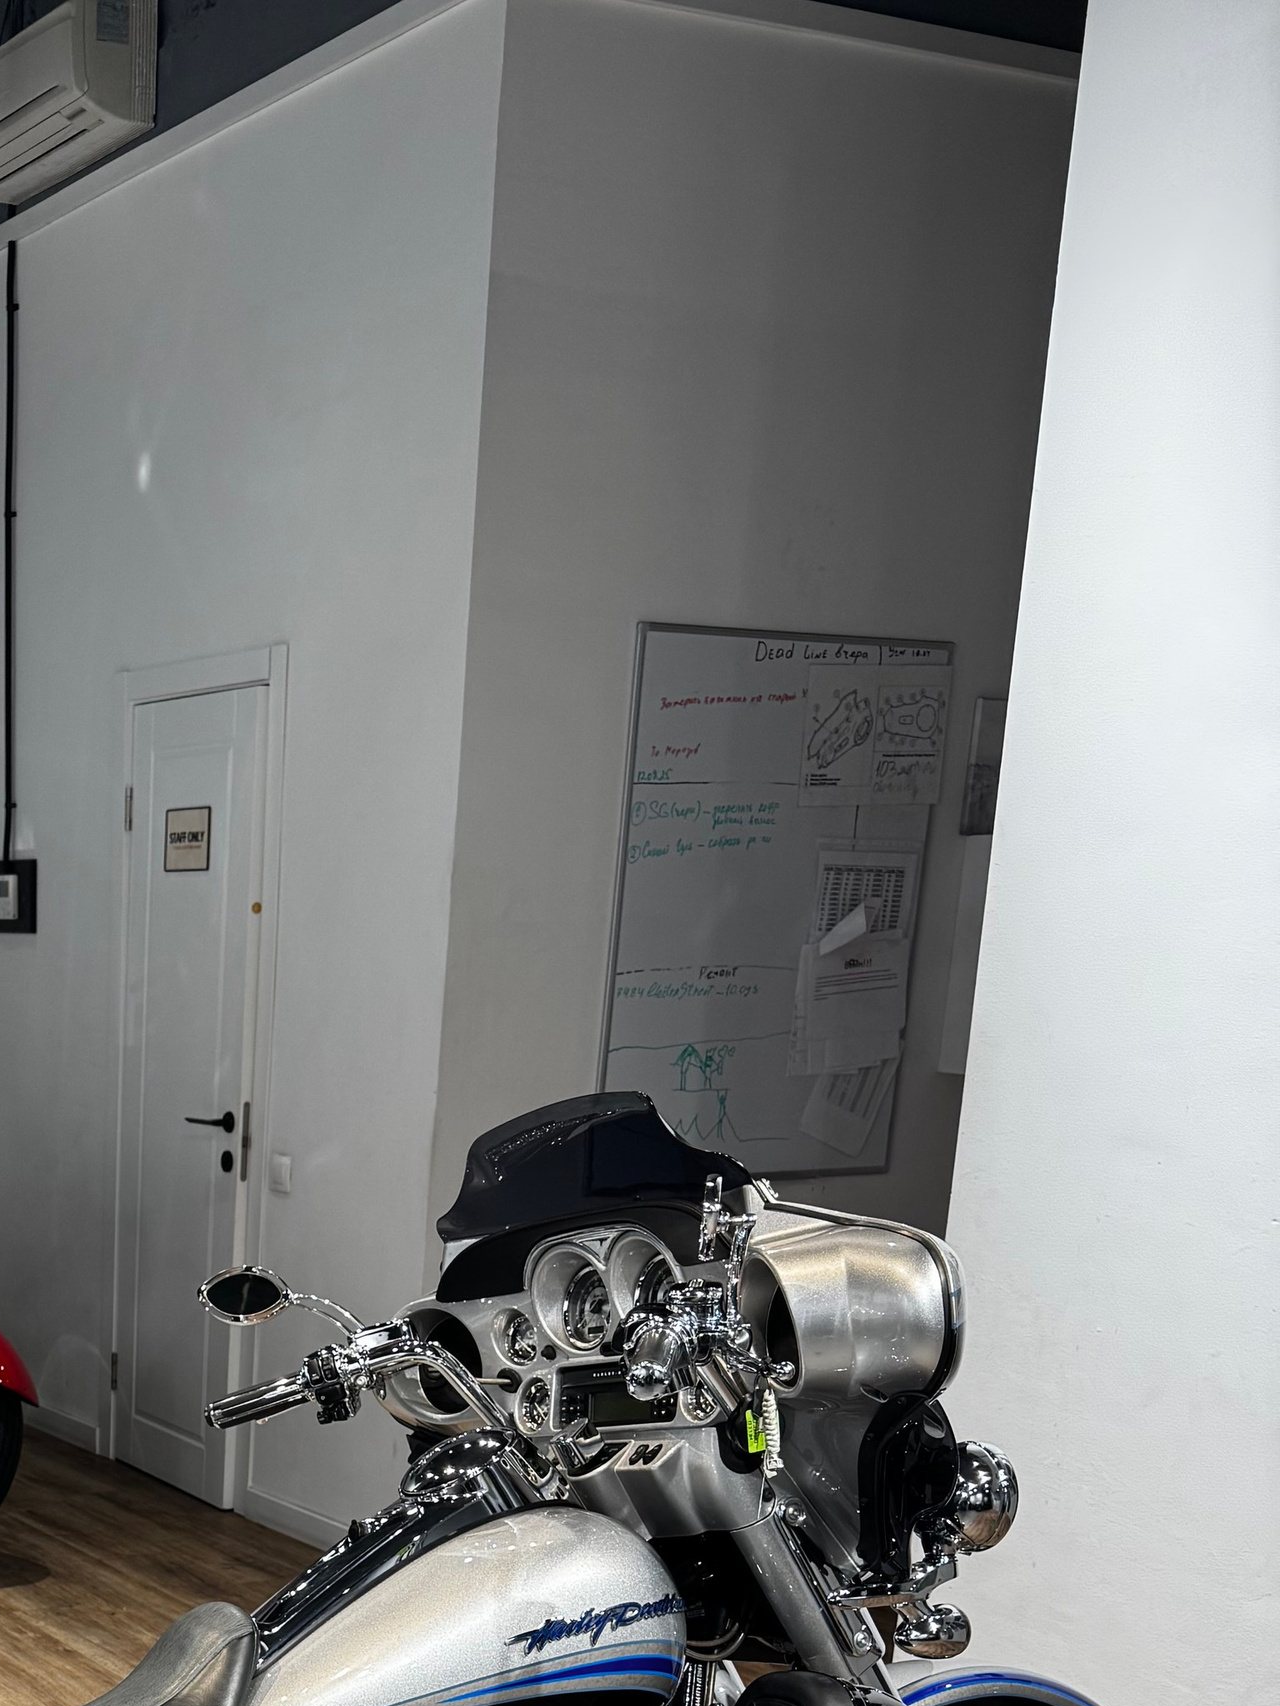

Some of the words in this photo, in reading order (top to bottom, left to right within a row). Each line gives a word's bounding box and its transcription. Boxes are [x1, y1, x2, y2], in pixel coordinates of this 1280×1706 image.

[169, 832, 187, 843] STAFF
[187, 831, 205, 842] ONLY
[503, 1592, 687, 1657] Harley-David
